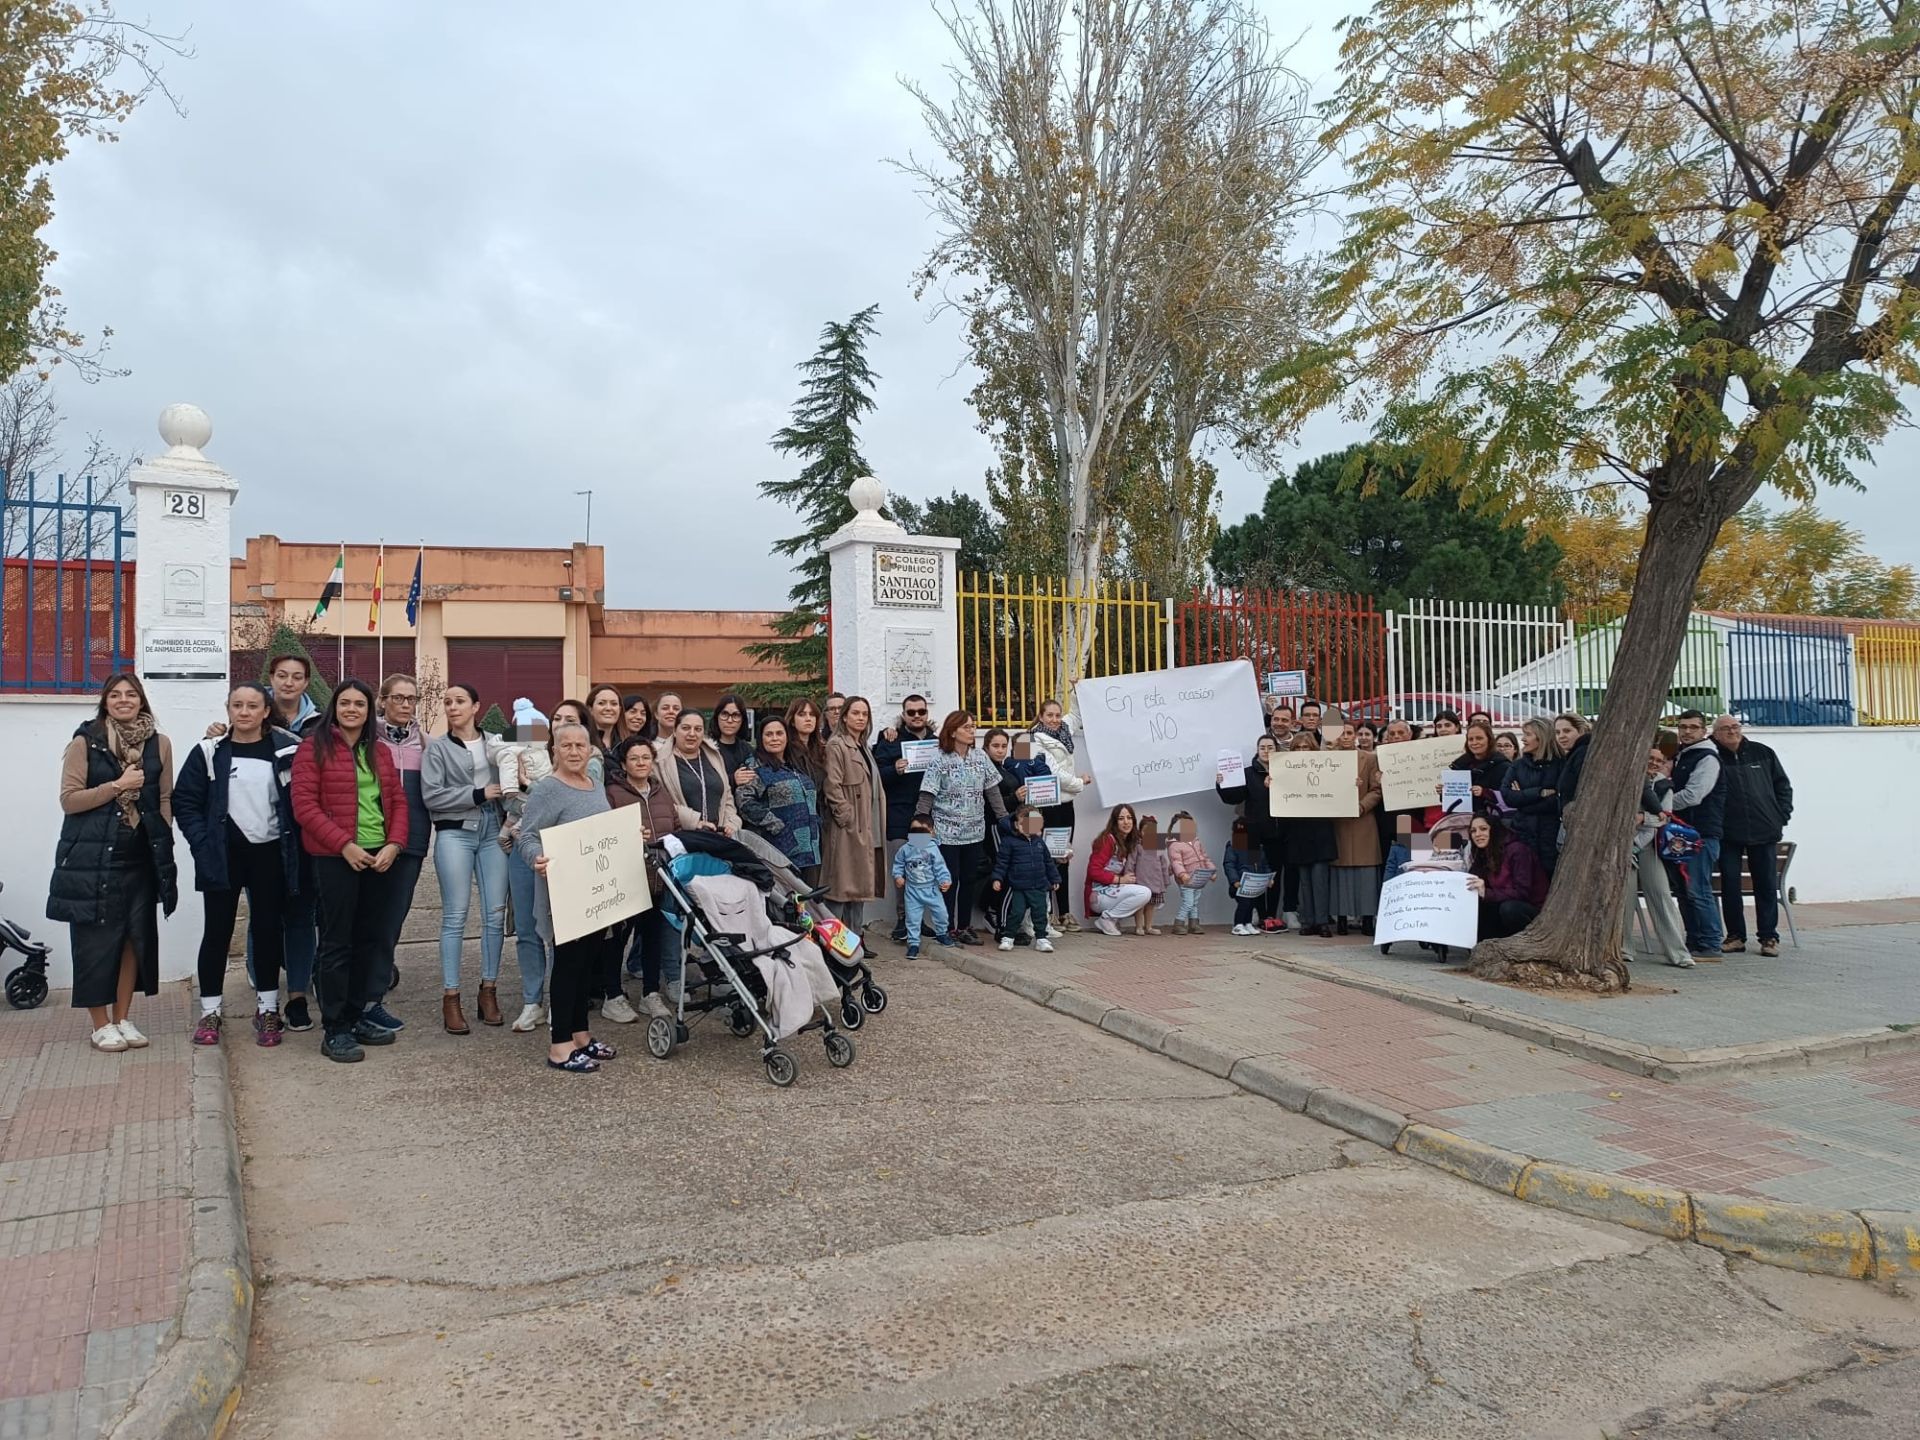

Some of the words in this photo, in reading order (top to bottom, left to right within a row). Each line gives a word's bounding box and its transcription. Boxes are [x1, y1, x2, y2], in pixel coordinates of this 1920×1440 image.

[171, 494, 200, 515] 28
[895, 556, 936, 565] COLEGIO
[897, 565, 934, 573] PUBLICO
[879, 576, 936, 589] SANTIAGO
[880, 588, 936, 601] APOSTOL
[192, 645, 222, 653] COMPAÑÍA
[1105, 686, 1133, 717] En
[1144, 684, 1166, 709] esta
[1150, 712, 1178, 743] NO
[595, 854, 610, 873] NO
